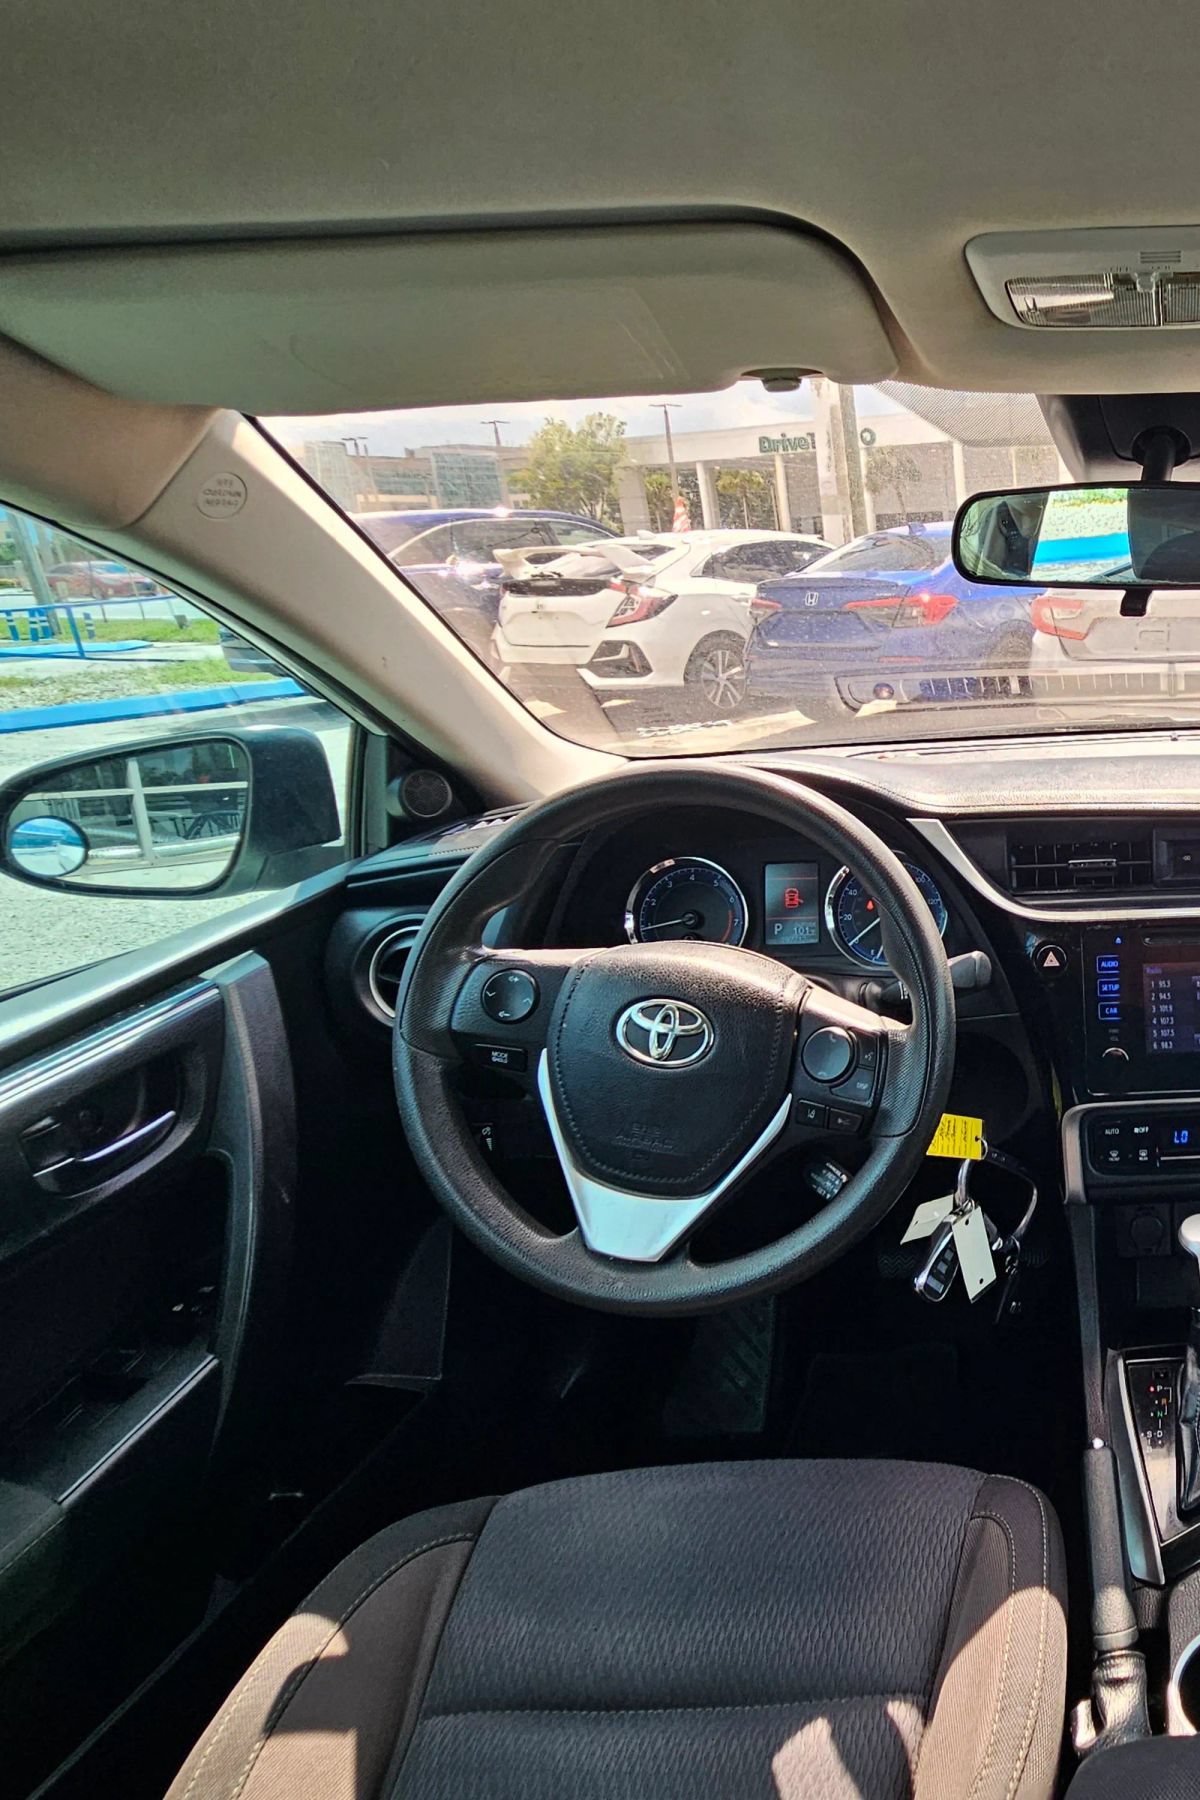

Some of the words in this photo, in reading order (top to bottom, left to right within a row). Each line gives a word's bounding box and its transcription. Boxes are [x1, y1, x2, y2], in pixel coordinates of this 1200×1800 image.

[843, 913, 852, 921] 20
[774, 923, 783, 935] P
[1101, 960, 1119, 968] AUDIO
[1102, 984, 1120, 992] SETUP
[1174, 1130, 1188, 1143] LO
